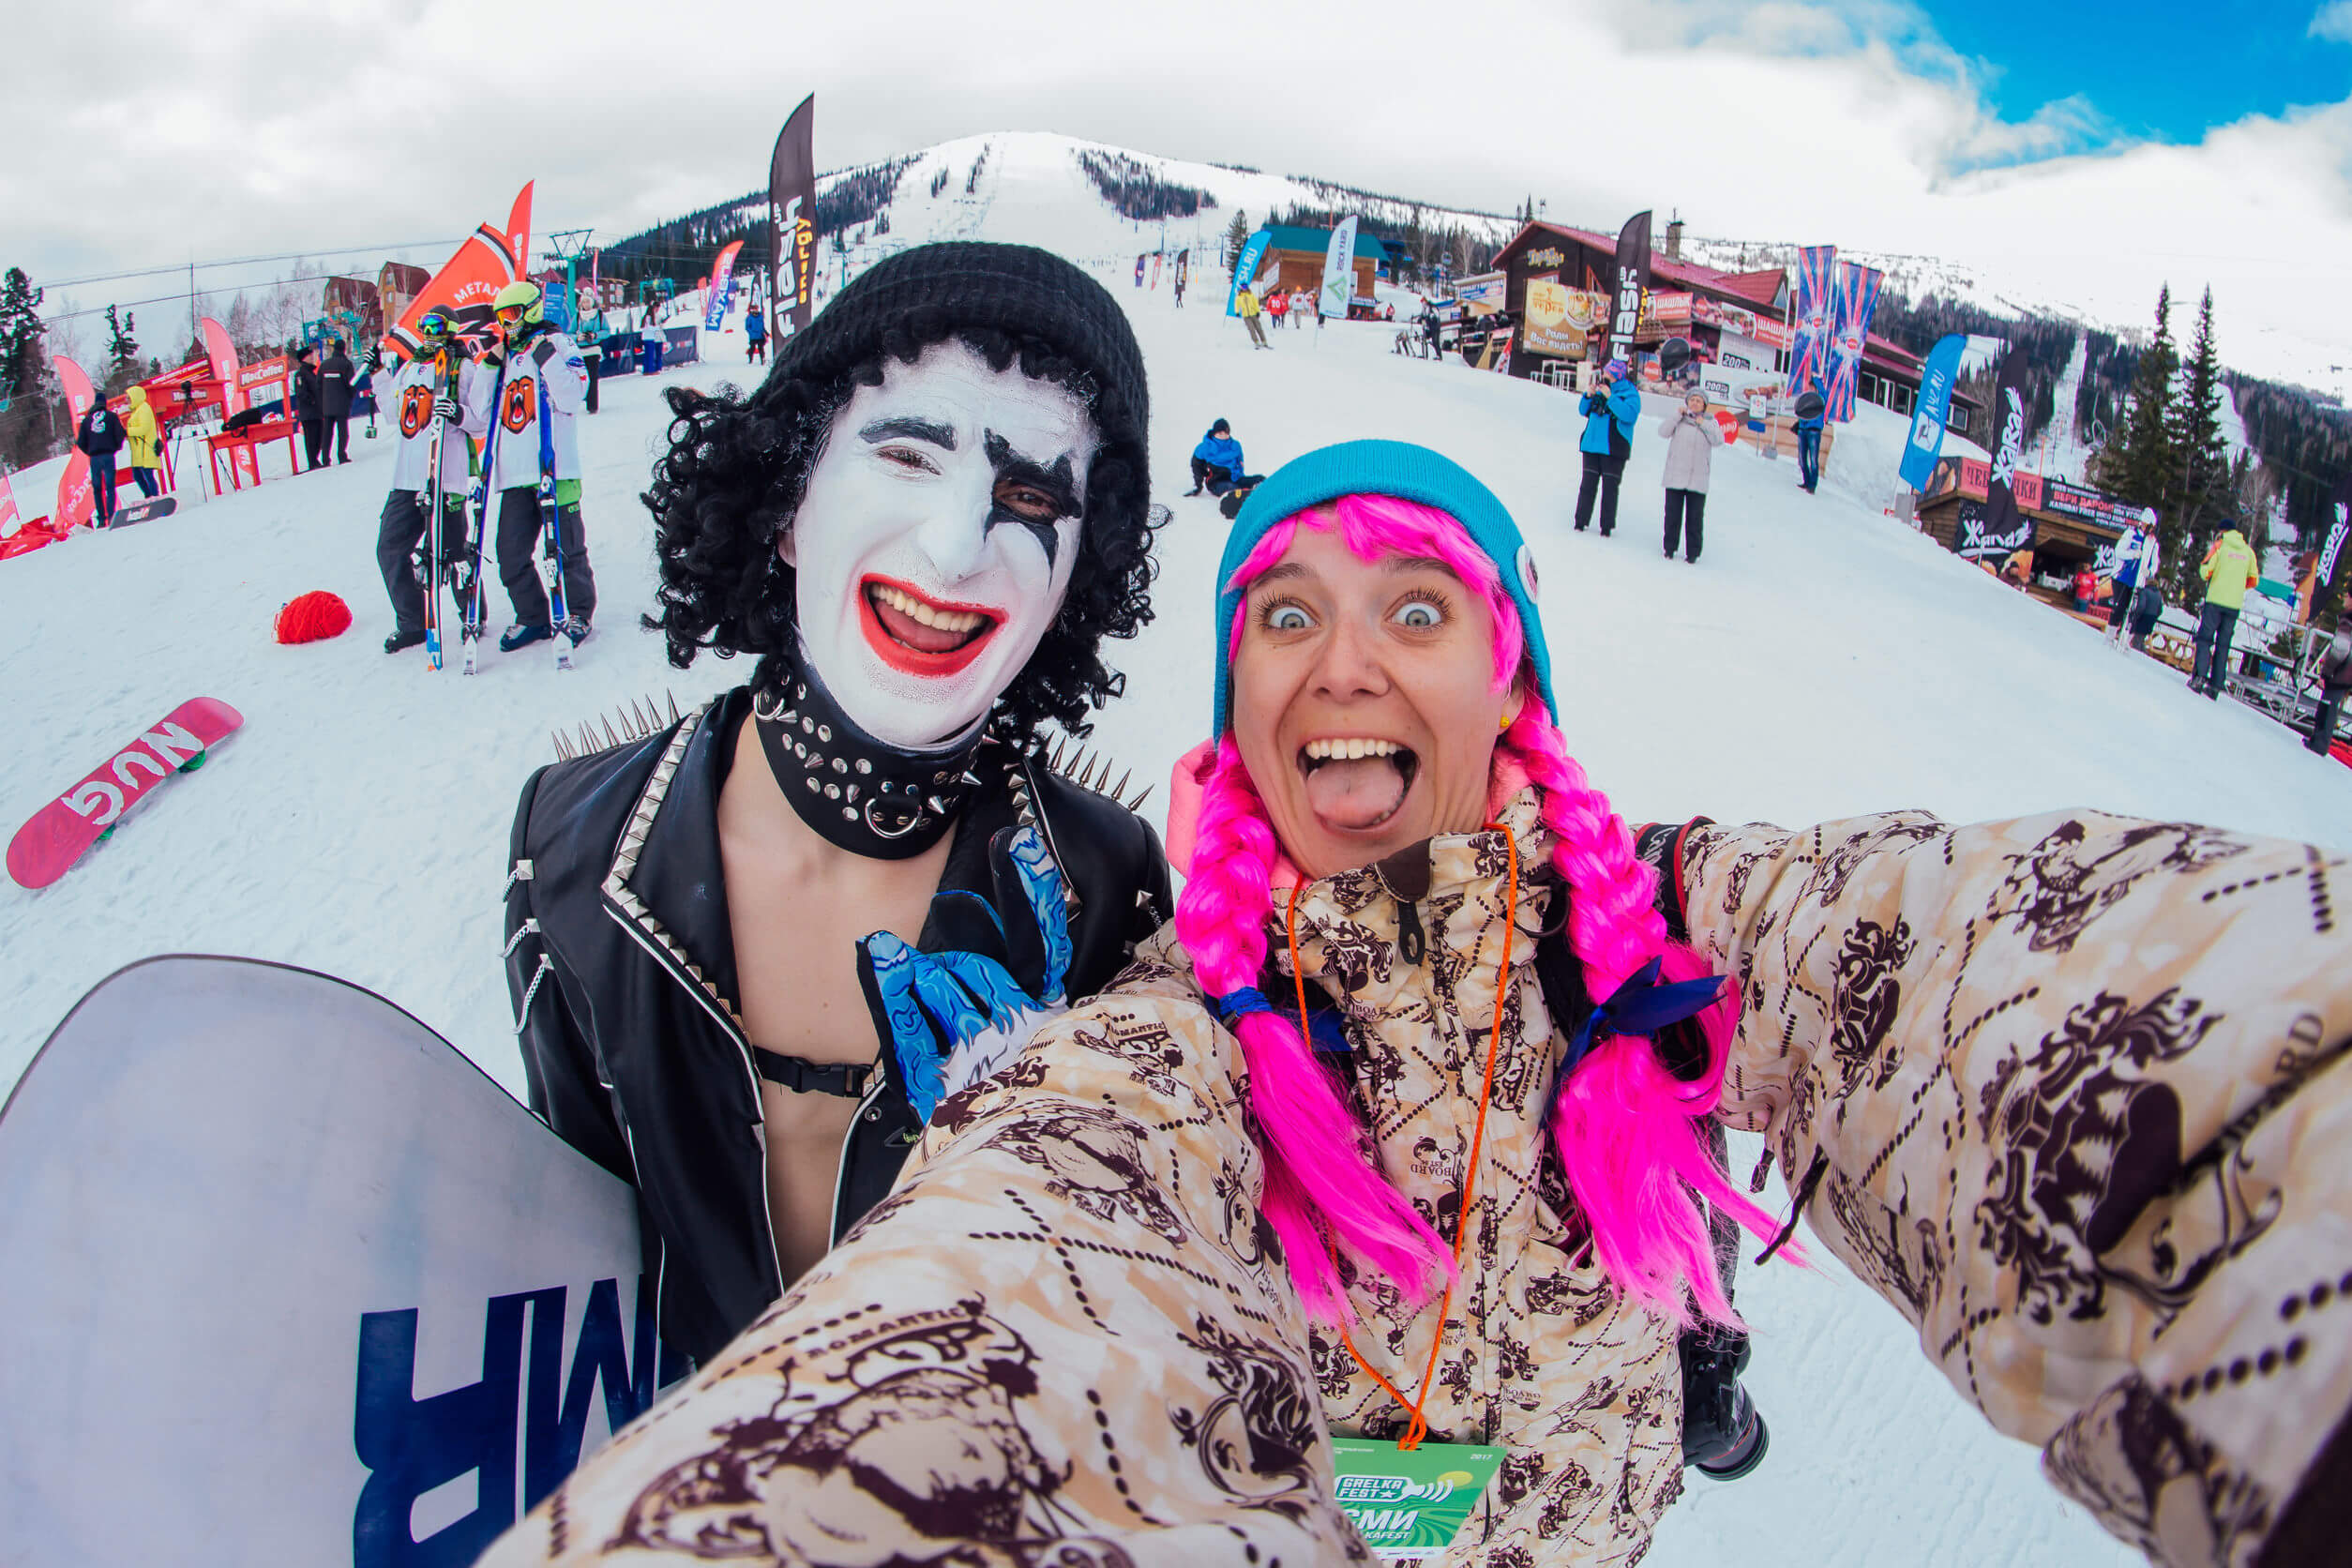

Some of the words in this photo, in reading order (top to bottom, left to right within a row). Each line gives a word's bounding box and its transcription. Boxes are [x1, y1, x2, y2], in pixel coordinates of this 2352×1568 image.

[1723, 354, 1741, 368] 200
[60, 721, 204, 825] NUG
[1410, 1163, 1452, 1177] BOARD
[806, 1307, 966, 1359] ROMANTIC
[1339, 1488, 1380, 1498] FEST
